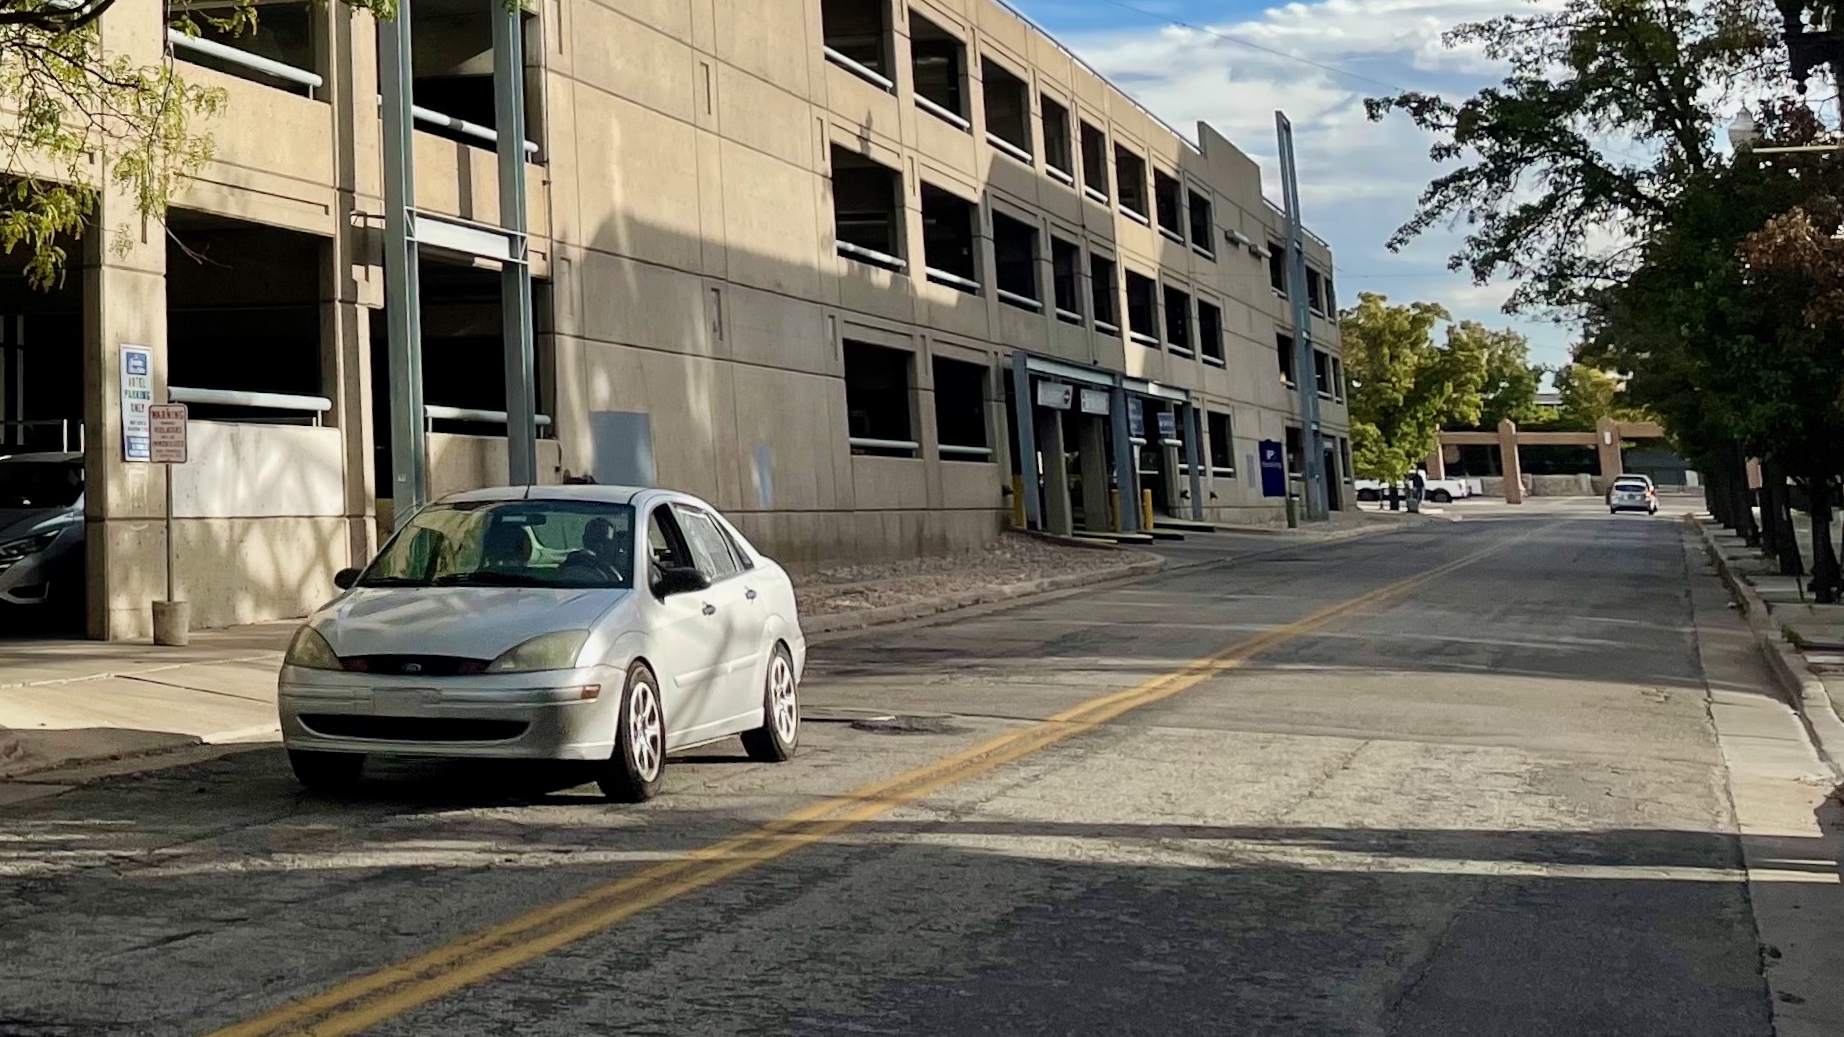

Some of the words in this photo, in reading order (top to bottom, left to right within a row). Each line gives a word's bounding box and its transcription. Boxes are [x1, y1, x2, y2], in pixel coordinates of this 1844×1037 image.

[128, 377, 146, 388] HOTEL
[124, 390, 150, 400] PARKING
[130, 403, 145, 413] ONLY
[151, 410, 184, 420] WARNING
